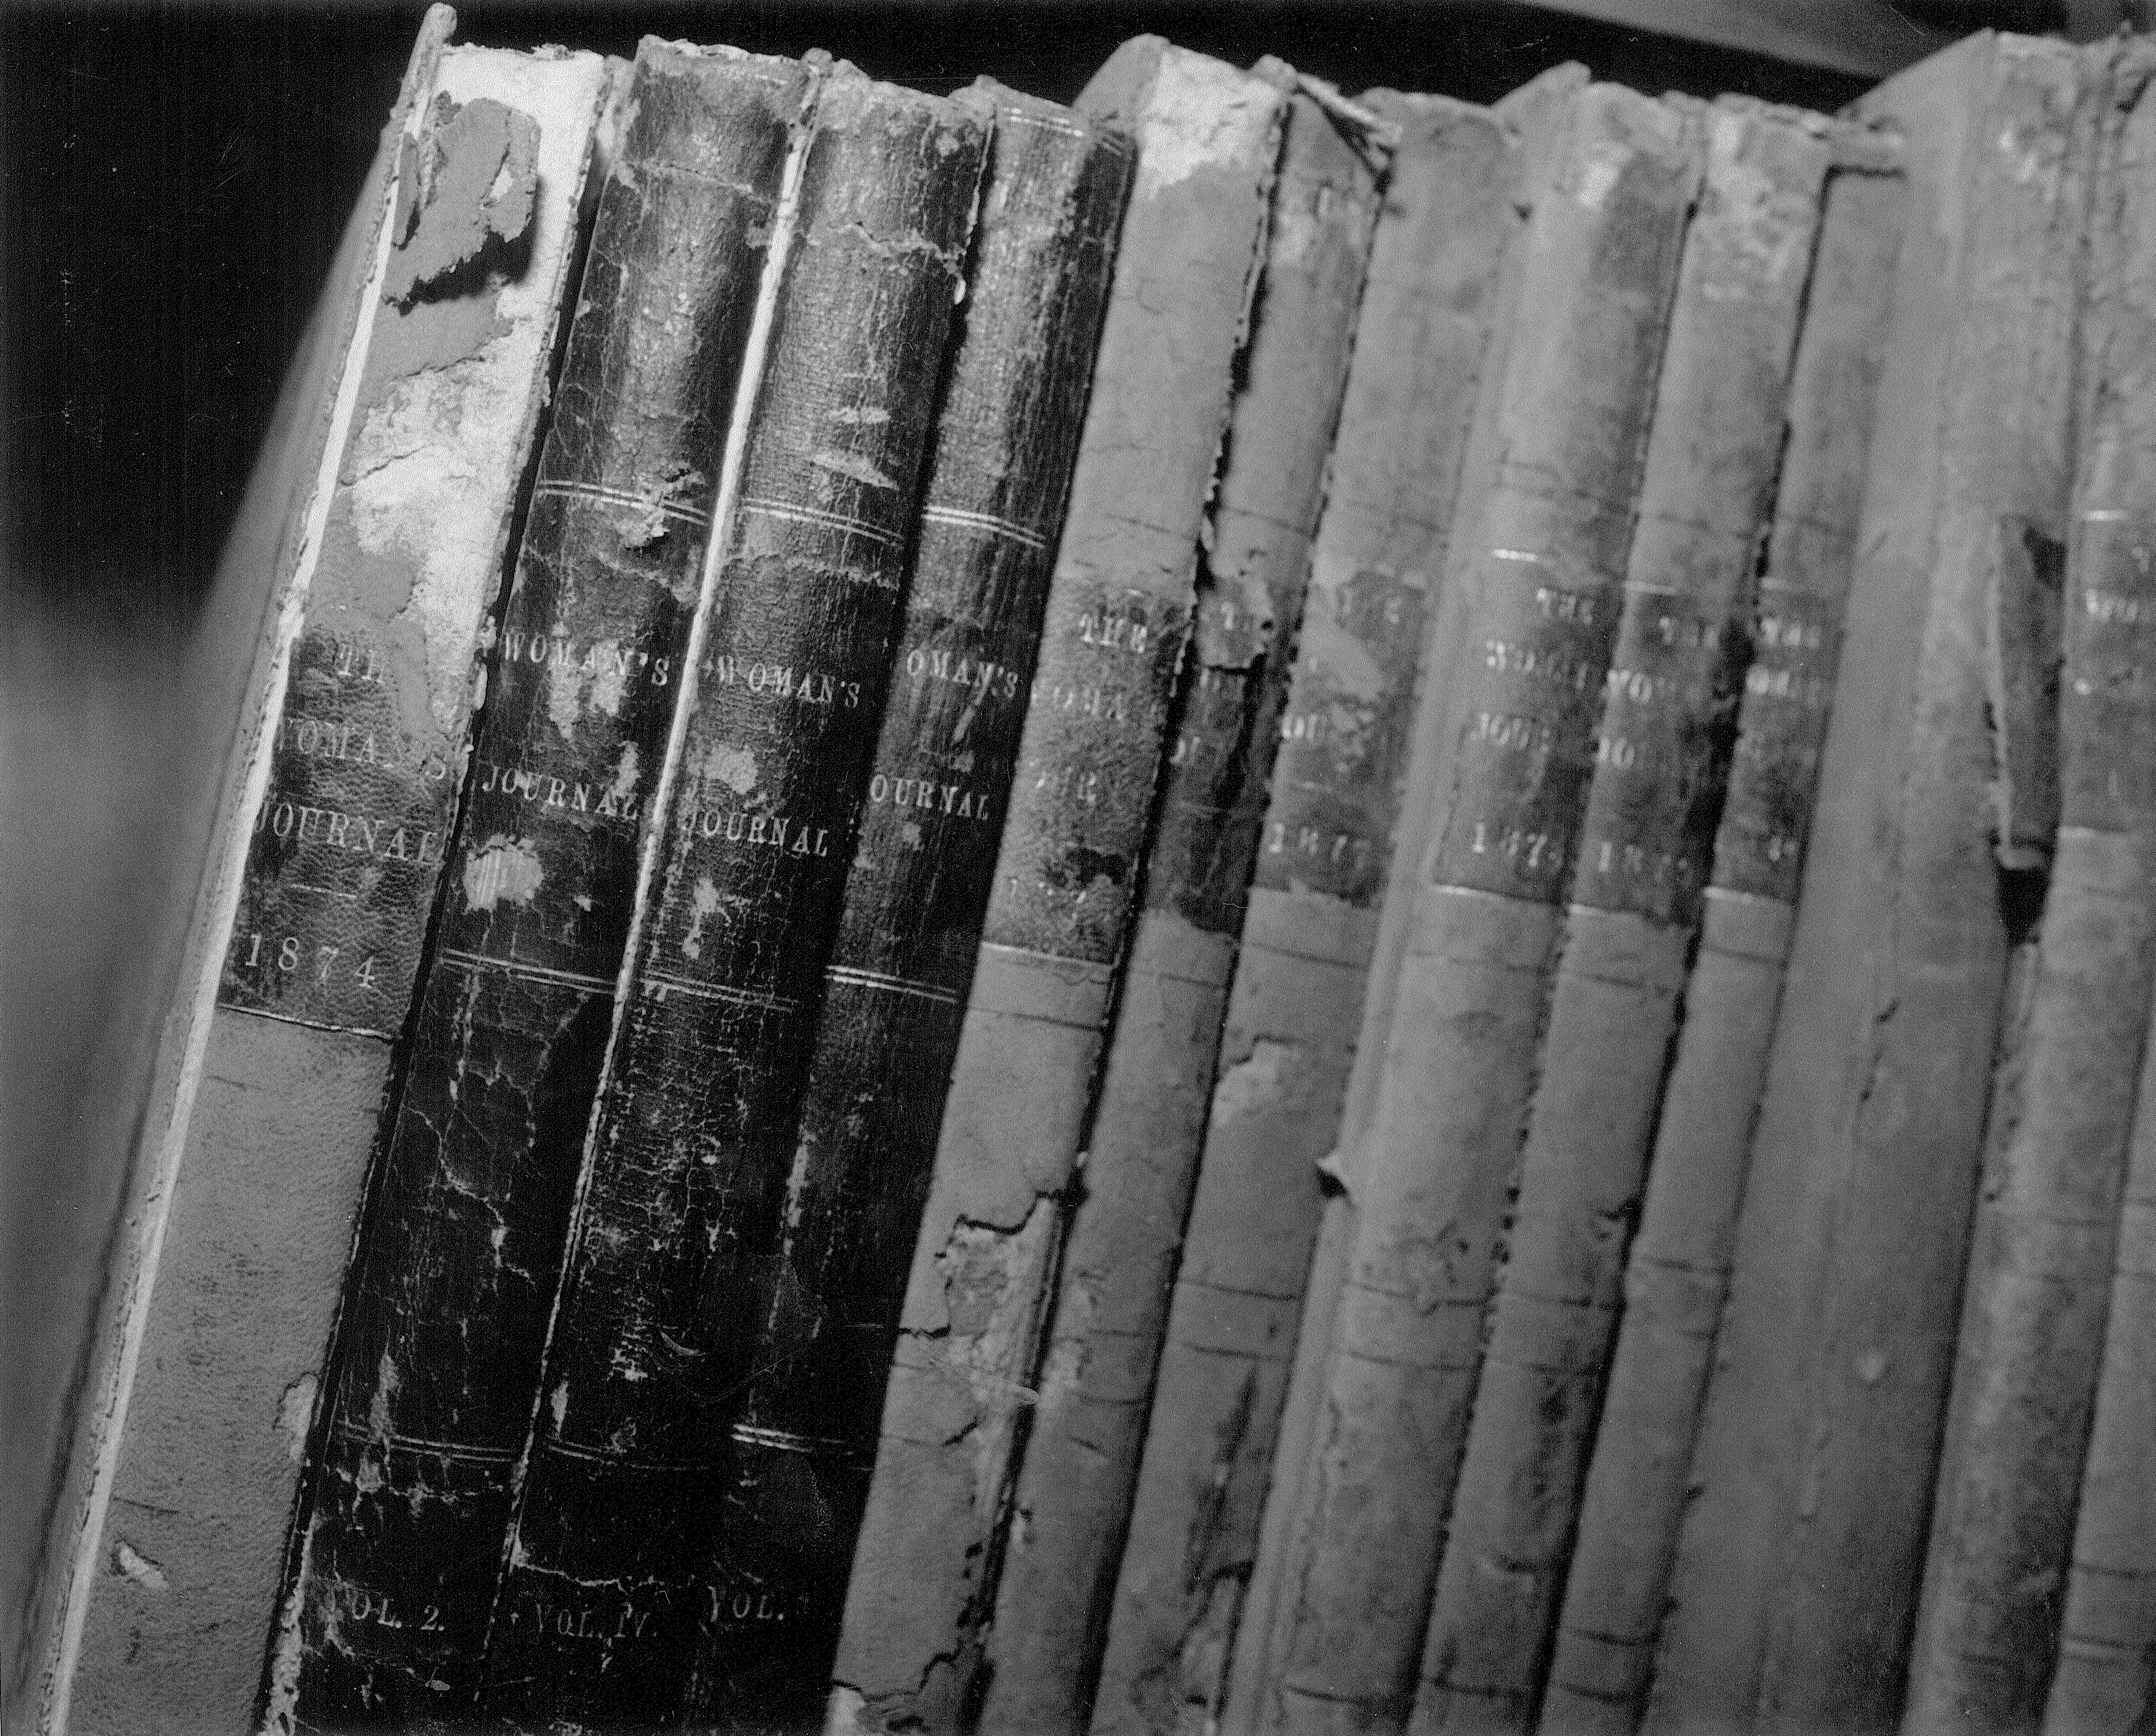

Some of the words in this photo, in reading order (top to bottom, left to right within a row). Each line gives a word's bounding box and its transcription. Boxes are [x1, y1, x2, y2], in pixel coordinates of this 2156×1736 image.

[713, 655, 861, 709] WOMAN'S
[906, 649, 1019, 700] OMAN'S
[481, 764, 640, 821] JOURNAL
[869, 773, 990, 821] OURNAL
[681, 807, 830, 858] JOURNAL
[245, 933, 379, 989] 1874
[419, 1603, 446, 1633] 2.
